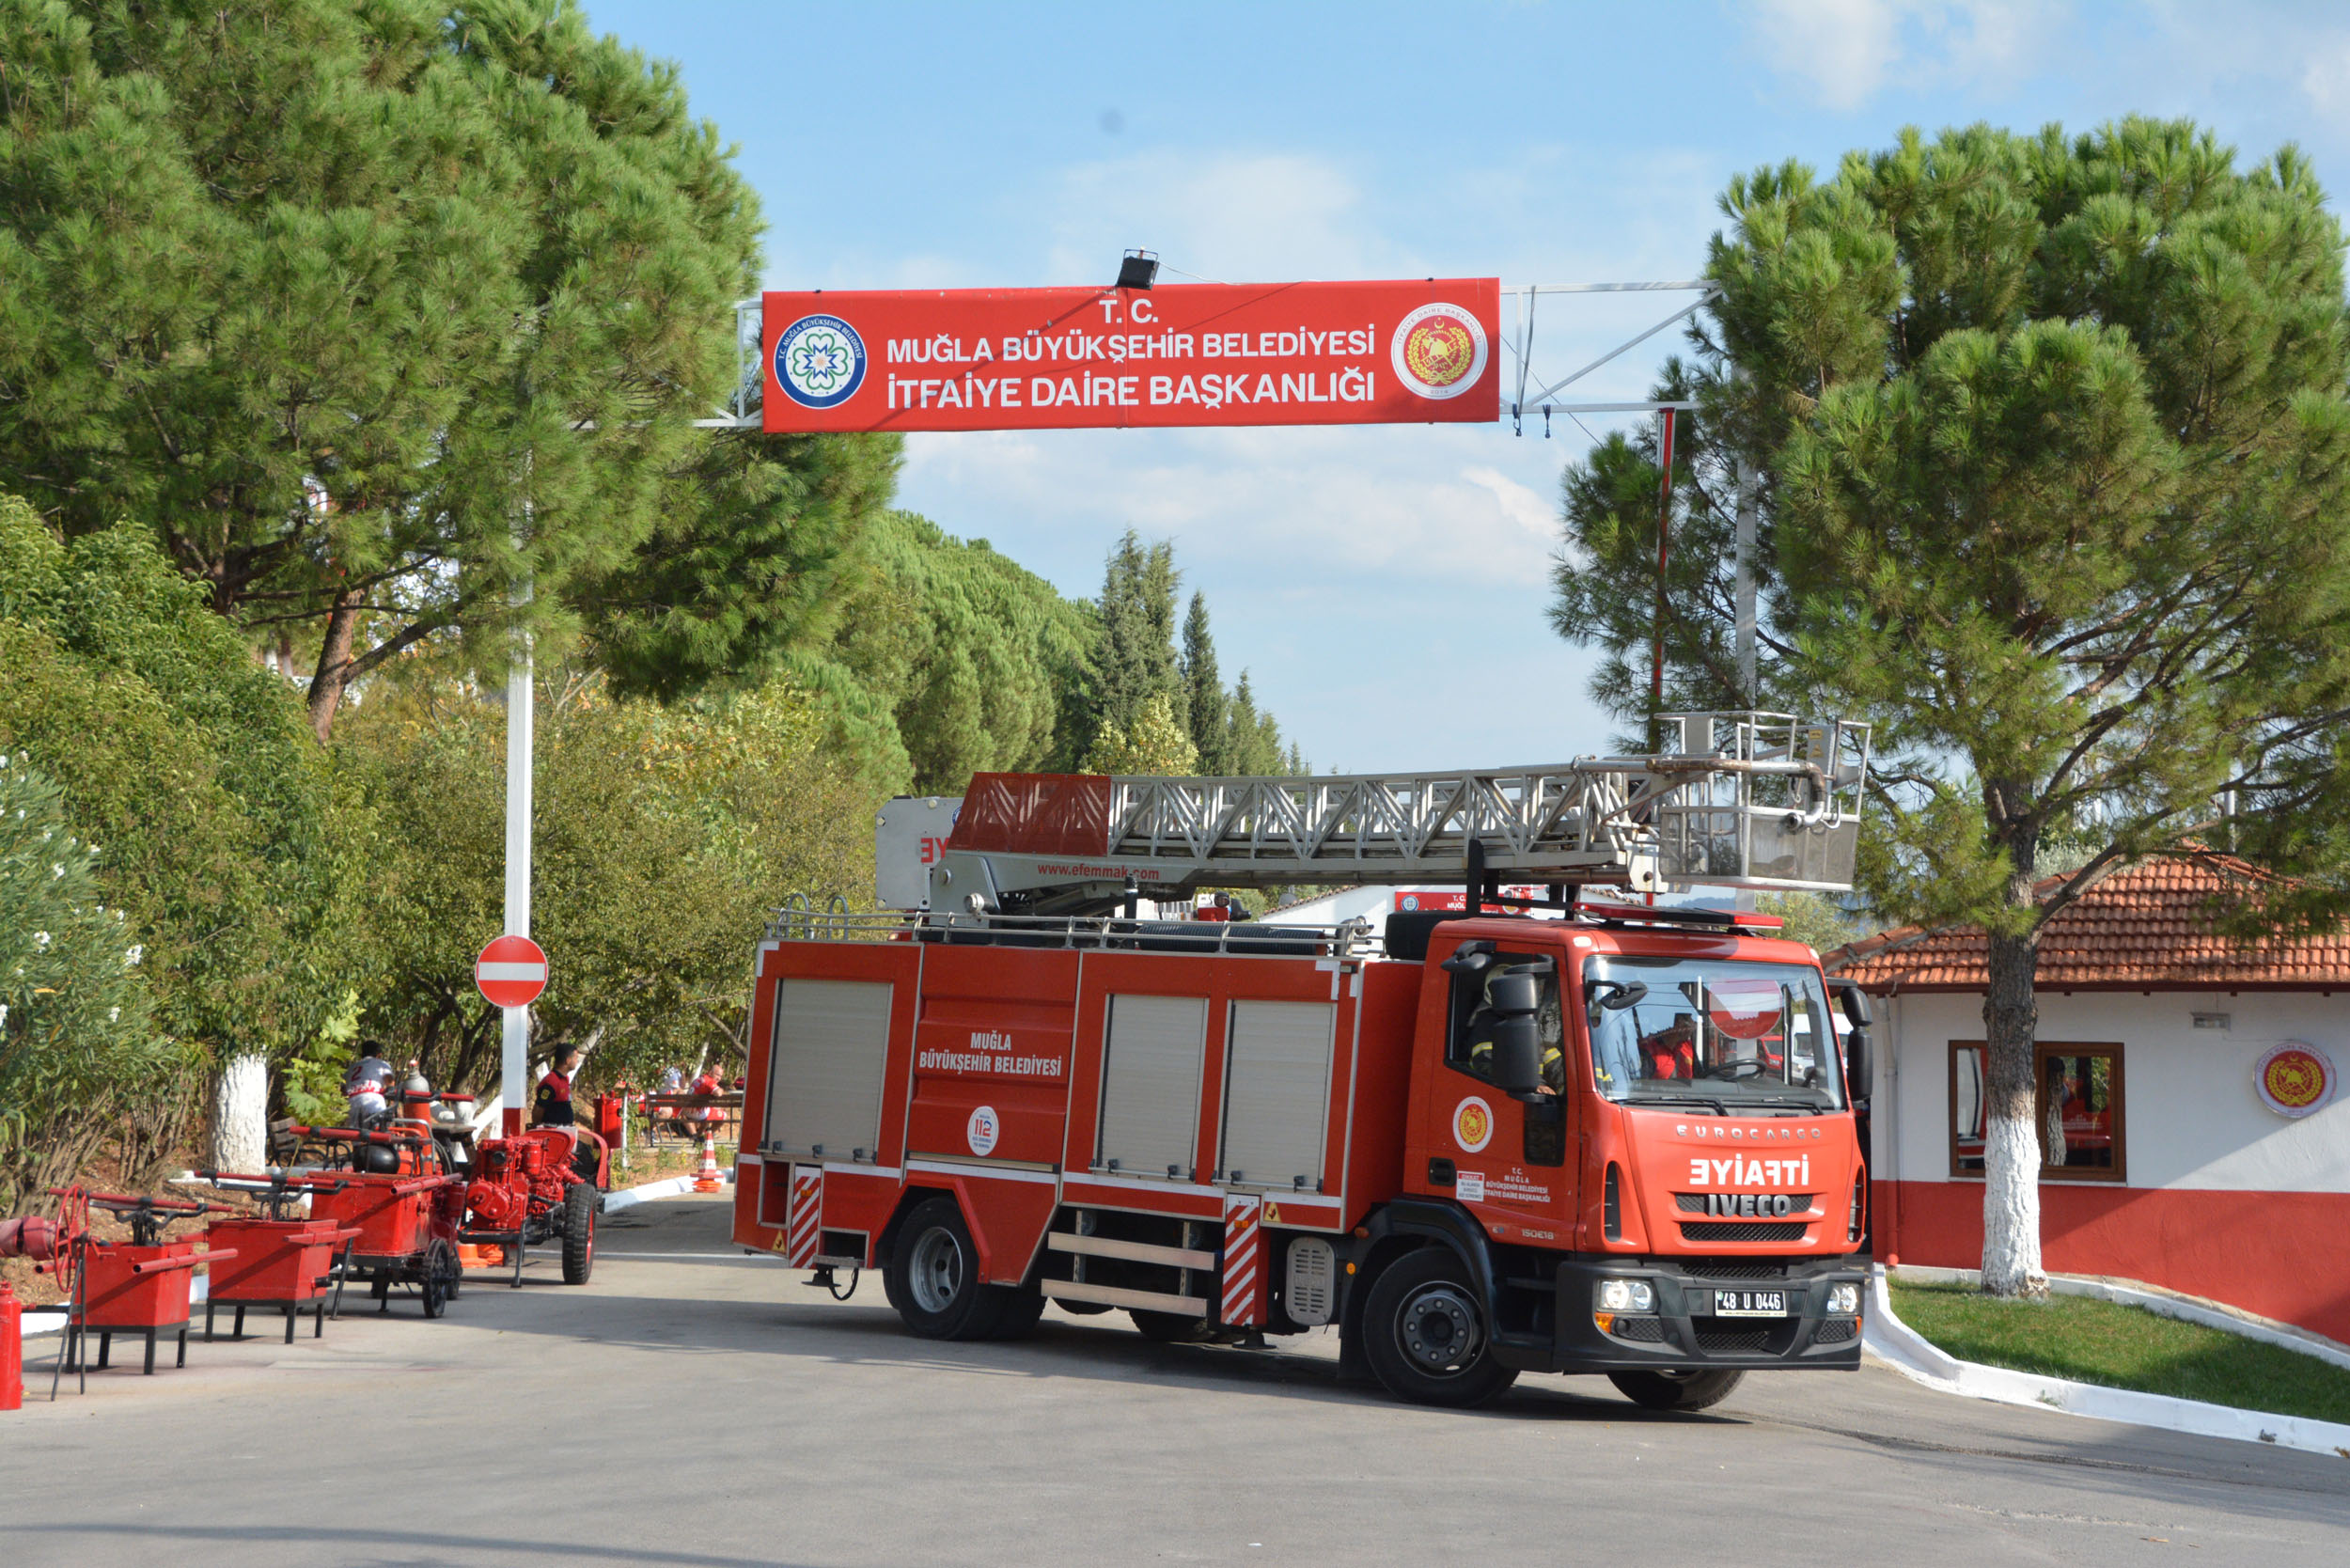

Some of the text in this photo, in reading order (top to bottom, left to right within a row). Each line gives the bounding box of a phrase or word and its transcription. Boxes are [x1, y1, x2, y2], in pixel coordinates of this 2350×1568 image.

[1099, 298, 1159, 323] T. C.
[887, 323, 1375, 364] MUĞLA BÜYÜKŞEHİR BELEDİYESİ
[887, 366, 1374, 409] İTFAİYE DAİRE BAŞKANLIĞI
[1037, 863, 1160, 881] www.efemmakcom
[970, 1029, 1012, 1051] MUĞLA
[918, 1047, 1062, 1076] BÜYÜKŞEHİR BELEDİYESİ
[974, 1119, 994, 1137] 112
[1676, 1124, 1821, 1139] EUROCARGO
[1706, 1193, 1792, 1218] IVECO
[1722, 1292, 1781, 1310] 48 U 0446
